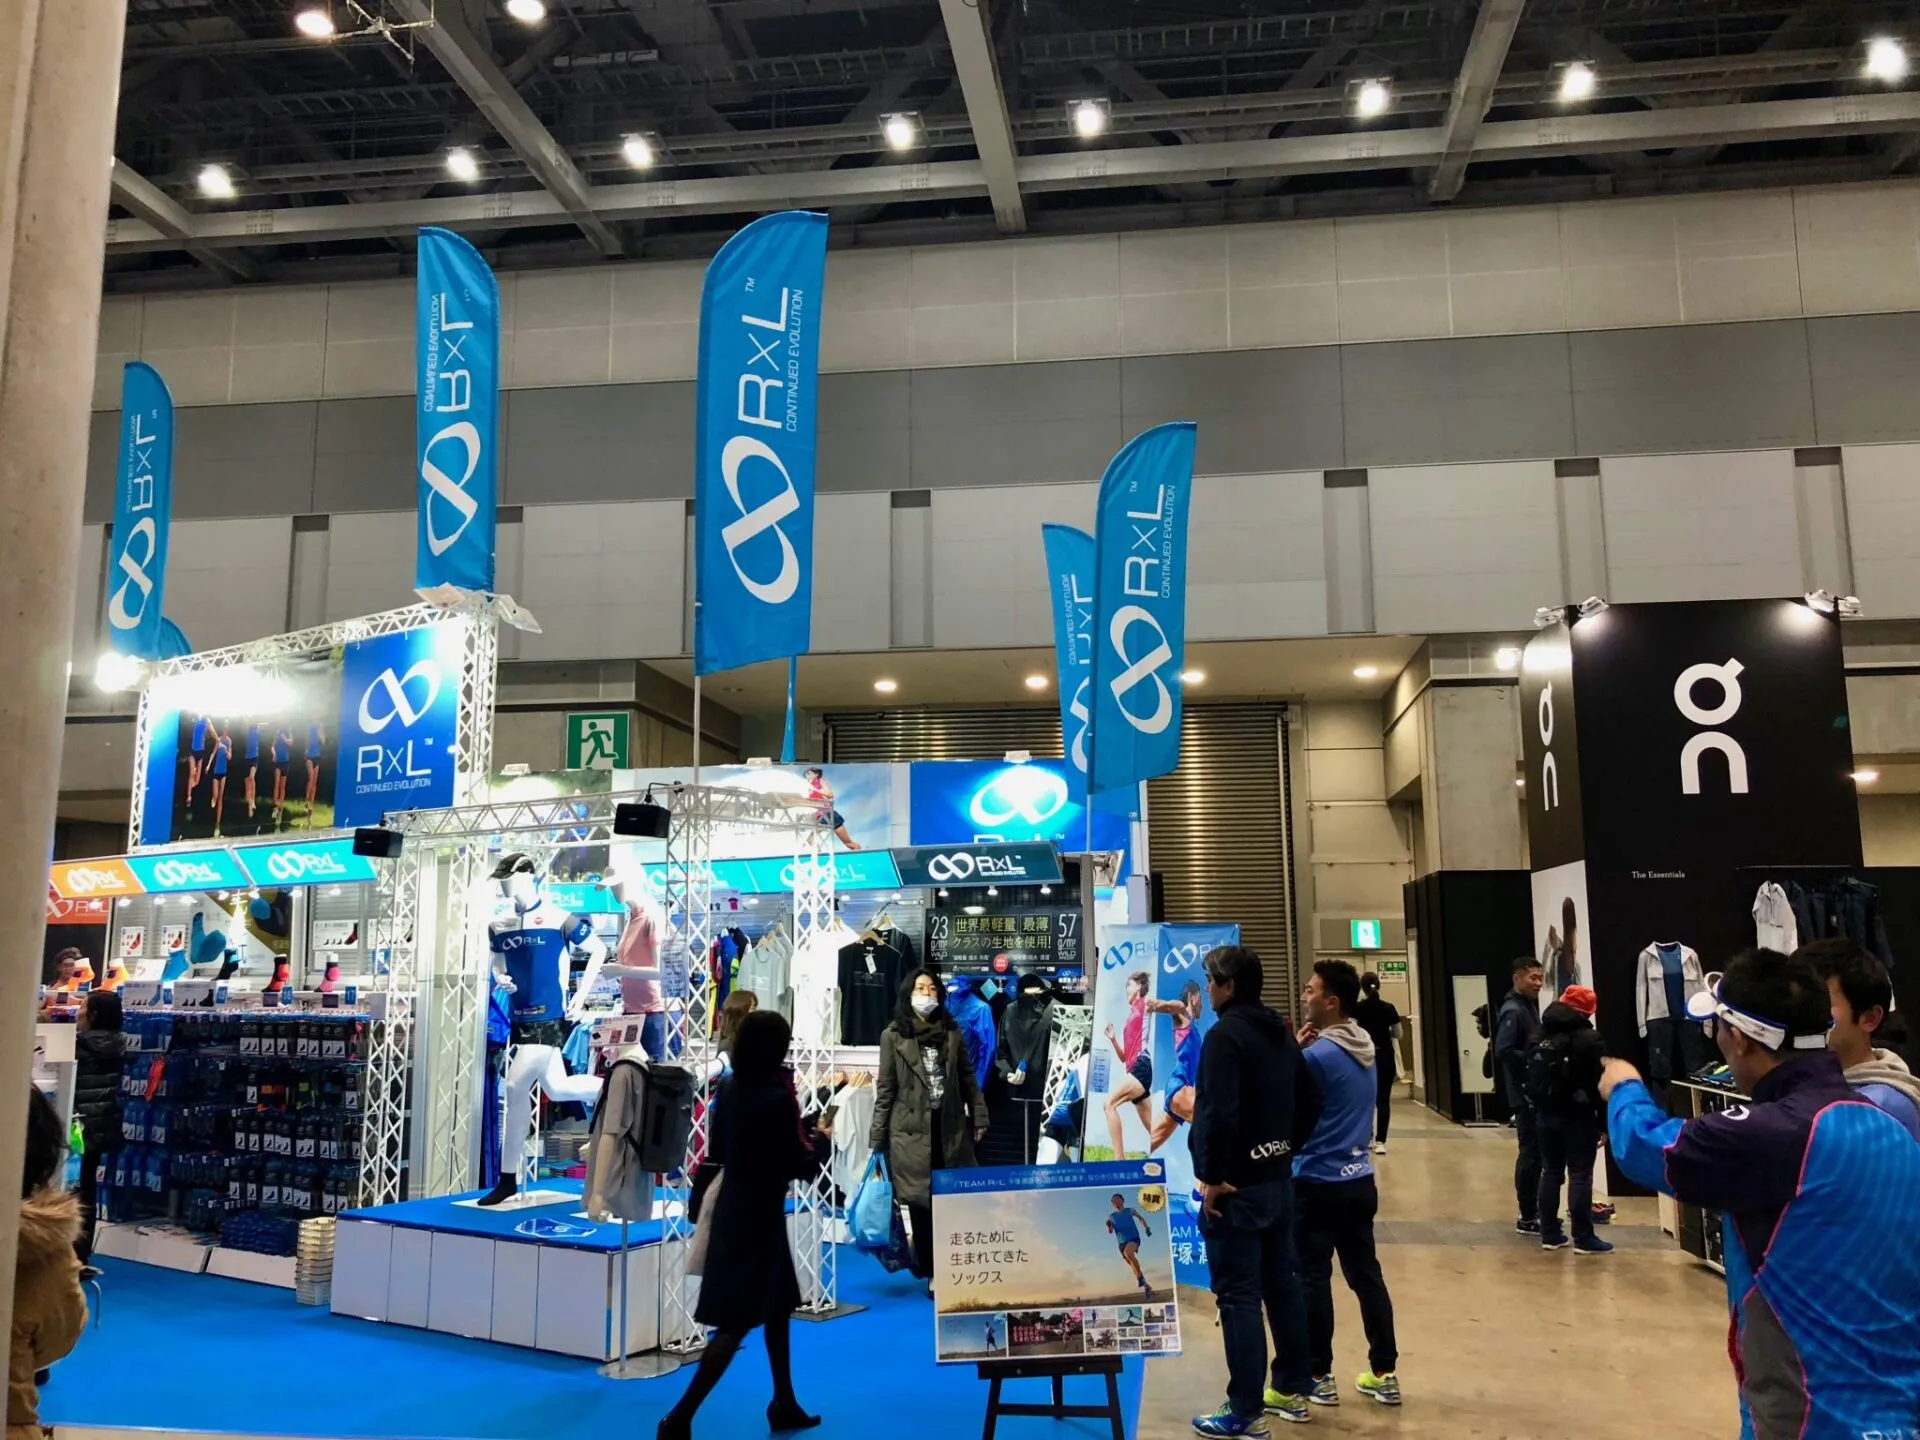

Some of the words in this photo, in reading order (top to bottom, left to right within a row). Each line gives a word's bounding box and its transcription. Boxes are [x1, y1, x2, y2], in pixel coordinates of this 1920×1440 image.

[789, 288, 804, 357] EVOLUTION
[786, 359, 800, 433] CONTINUED
[1163, 484, 1176, 539] EVOLUTION
[1161, 541, 1173, 599] CONTINUED
[355, 782, 393, 794] CONTINUED
[394, 778, 431, 791] EVOLUTION
[1631, 870, 1647, 879] The
[1648, 870, 1686, 879] Essentials
[931, 916, 949, 940] 23
[1058, 914, 1077, 938] 57
[950, 1230, 1015, 1246] 走るために
[950, 1249, 1028, 1266] 生まれてきた
[952, 1270, 1003, 1286] ソックス
